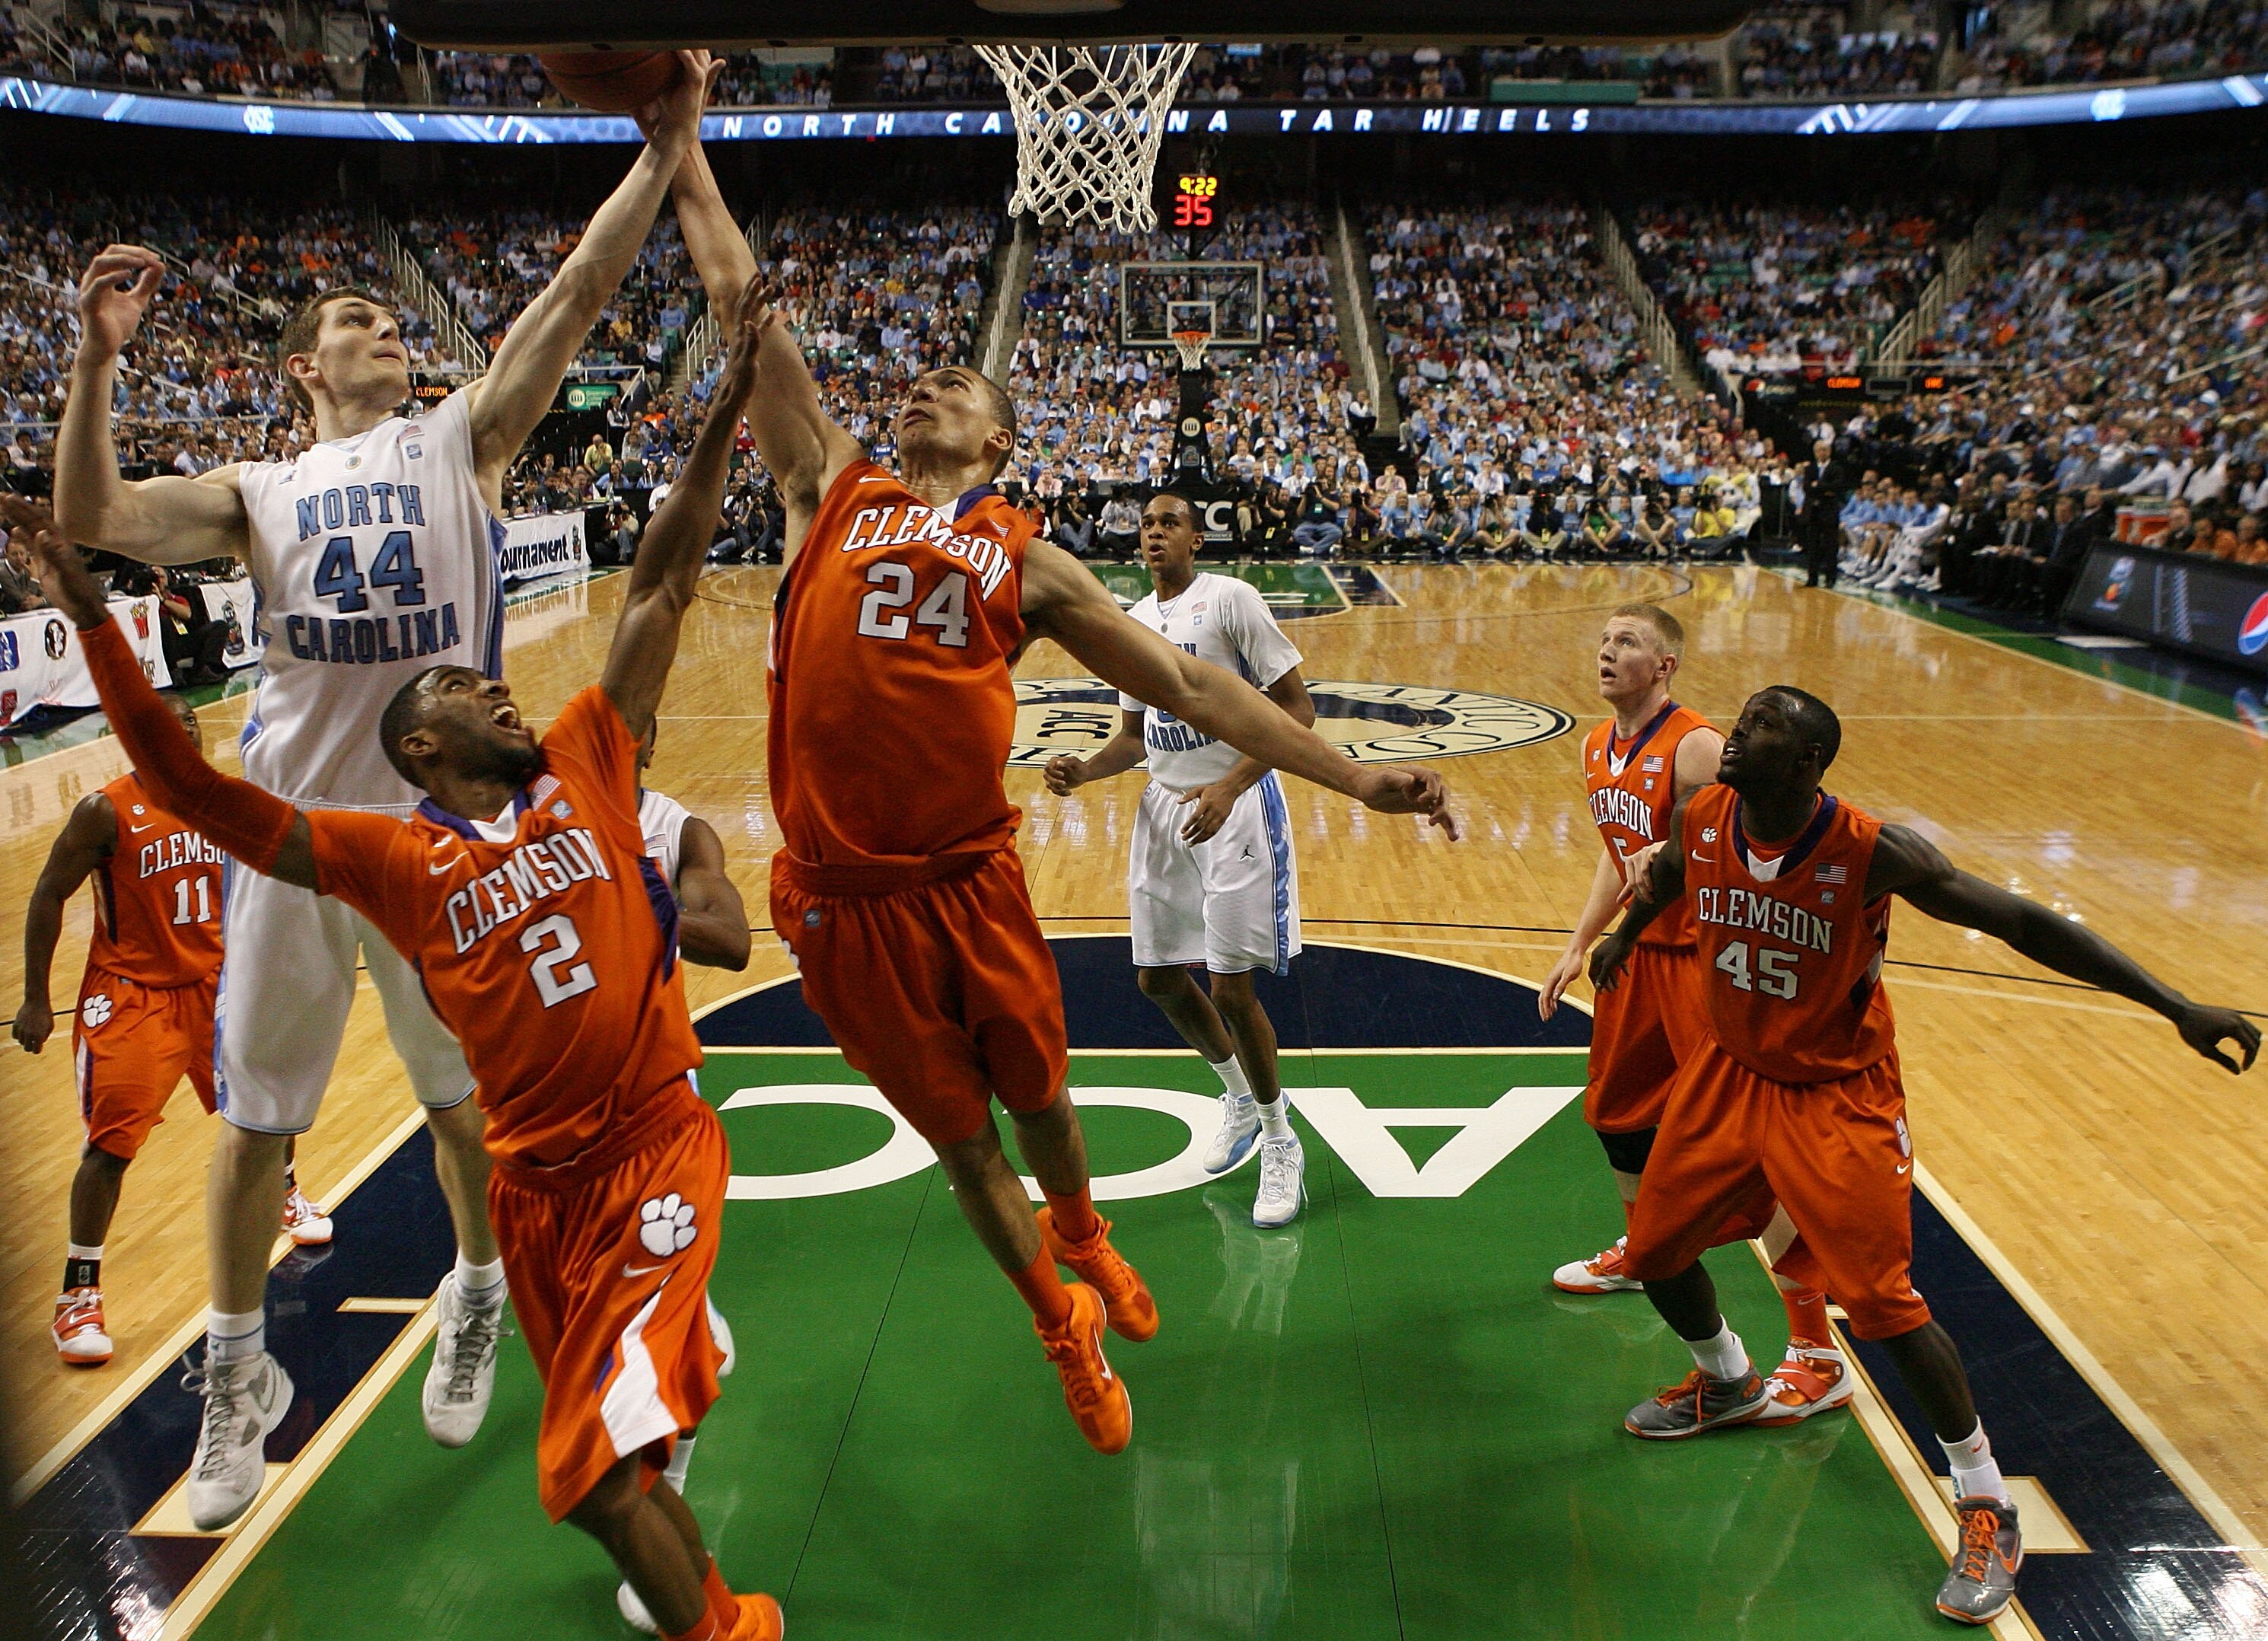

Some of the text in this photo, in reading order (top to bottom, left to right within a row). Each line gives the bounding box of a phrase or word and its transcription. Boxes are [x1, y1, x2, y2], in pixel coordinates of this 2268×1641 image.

[722, 108, 1591, 139] NORTH CAOINA TAR HEELS
[1174, 195, 1213, 226] 35
[1179, 177, 1218, 196] 9:22
[416, 387, 448, 397] CLEMSON
[296, 482, 425, 542] NORTH
[314, 531, 425, 613] 44
[499, 534, 569, 574] ournament
[842, 505, 1012, 601] CLEMSON
[286, 602, 460, 664] CAROLINA
[858, 562, 970, 647] 24
[1036, 709, 1113, 739] ACC
[1148, 724, 1218, 752] AROLI
[139, 830, 226, 879] CLEMSO
[173, 875, 211, 926] 11
[446, 827, 612, 955] CLEMSON
[1697, 887, 1833, 954] CLEMSON
[518, 913, 599, 1009] 2
[1715, 940, 1799, 1000] 45
[717, 1084, 1588, 1200] ACC
